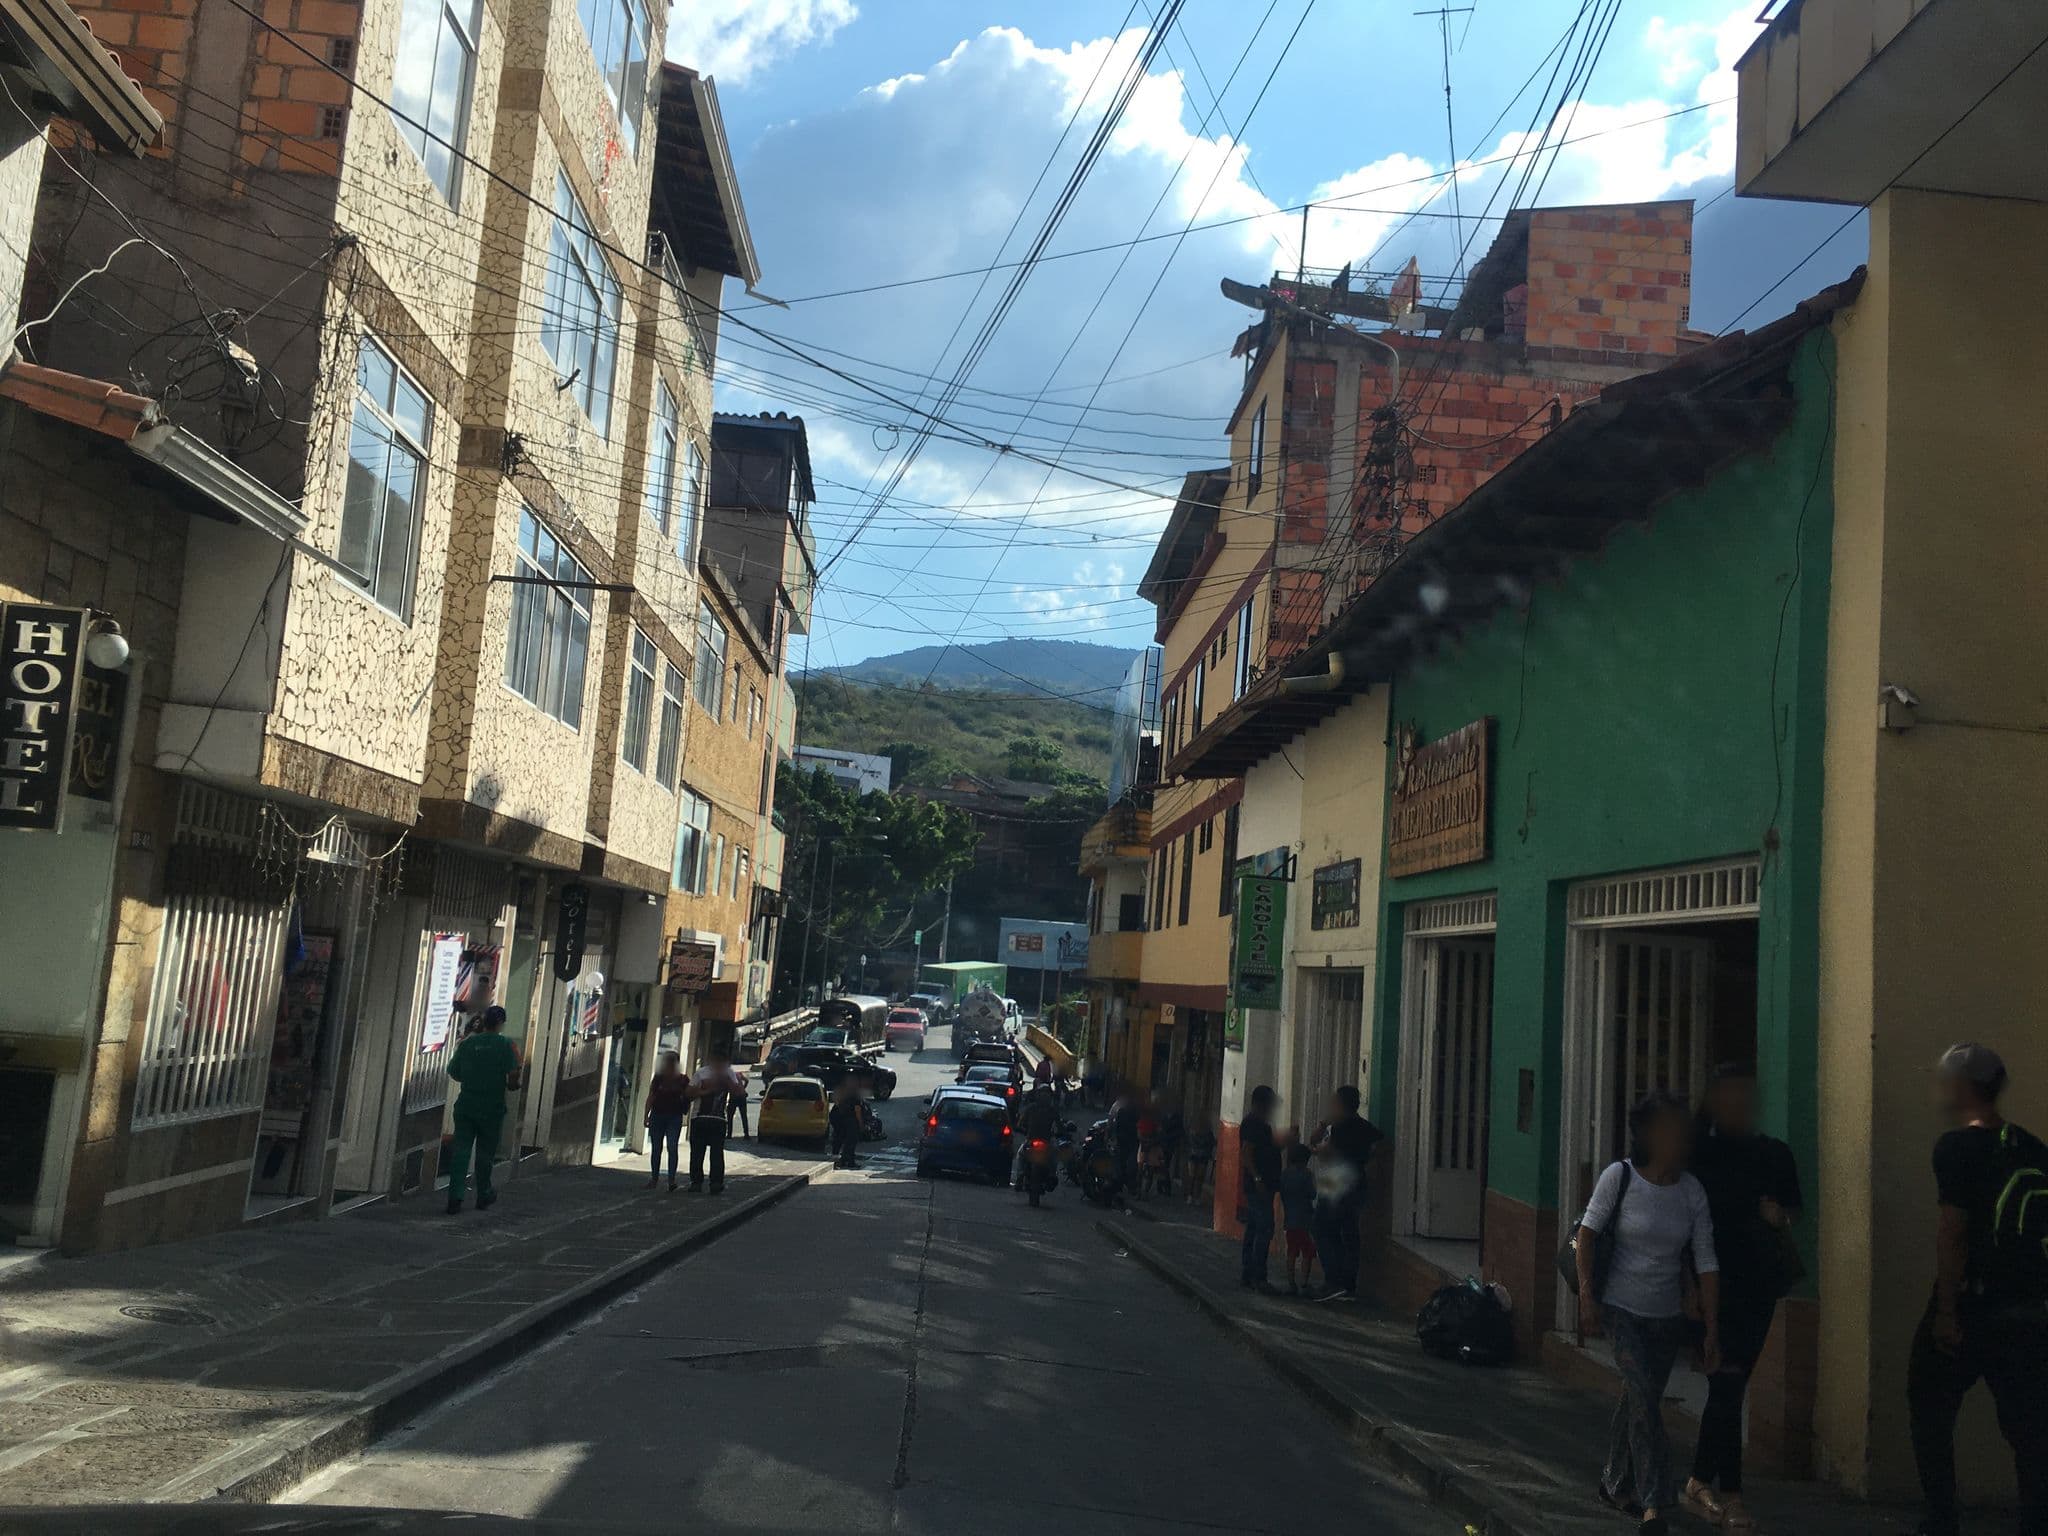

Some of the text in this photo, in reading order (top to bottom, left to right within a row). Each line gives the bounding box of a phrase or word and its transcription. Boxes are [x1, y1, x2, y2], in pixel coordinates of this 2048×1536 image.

[0, 620, 69, 814] HOTEL
[1432, 784, 1478, 832] PADRINO
[1249, 883, 1274, 961] CANOTAJE
